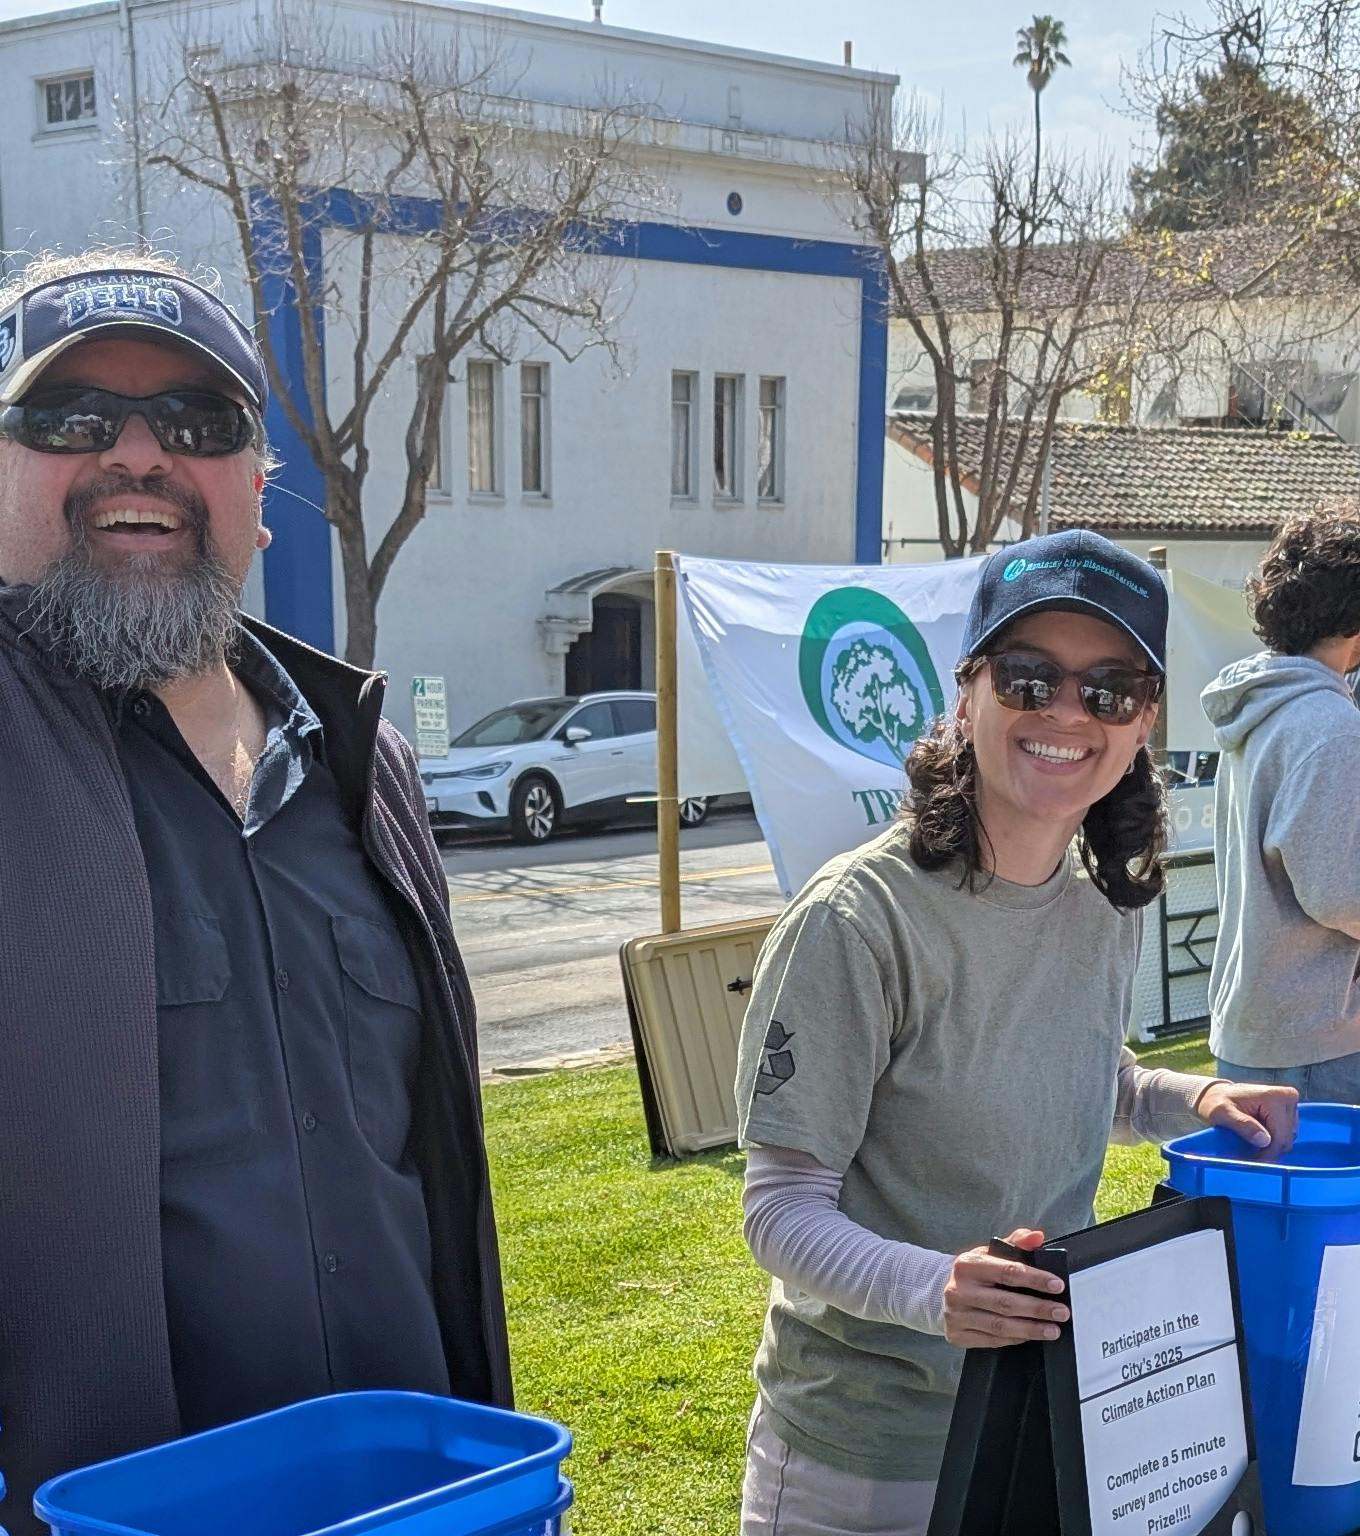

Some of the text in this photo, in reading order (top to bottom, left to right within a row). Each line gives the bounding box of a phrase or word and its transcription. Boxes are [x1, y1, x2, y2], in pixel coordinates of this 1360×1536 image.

[64, 285, 182, 328] BELLS
[414, 679, 424, 696] 2
[1100, 1312, 1199, 1360] Participate in the
[1120, 1344, 1183, 1383] City's 2025
[1100, 1371, 1216, 1426] Climate Action Plan
[1105, 1435, 1226, 1491] Complete a 5 minute
[1110, 1464, 1228, 1521] survey and choose a
[1146, 1502, 1192, 1535] Prize!!!!
